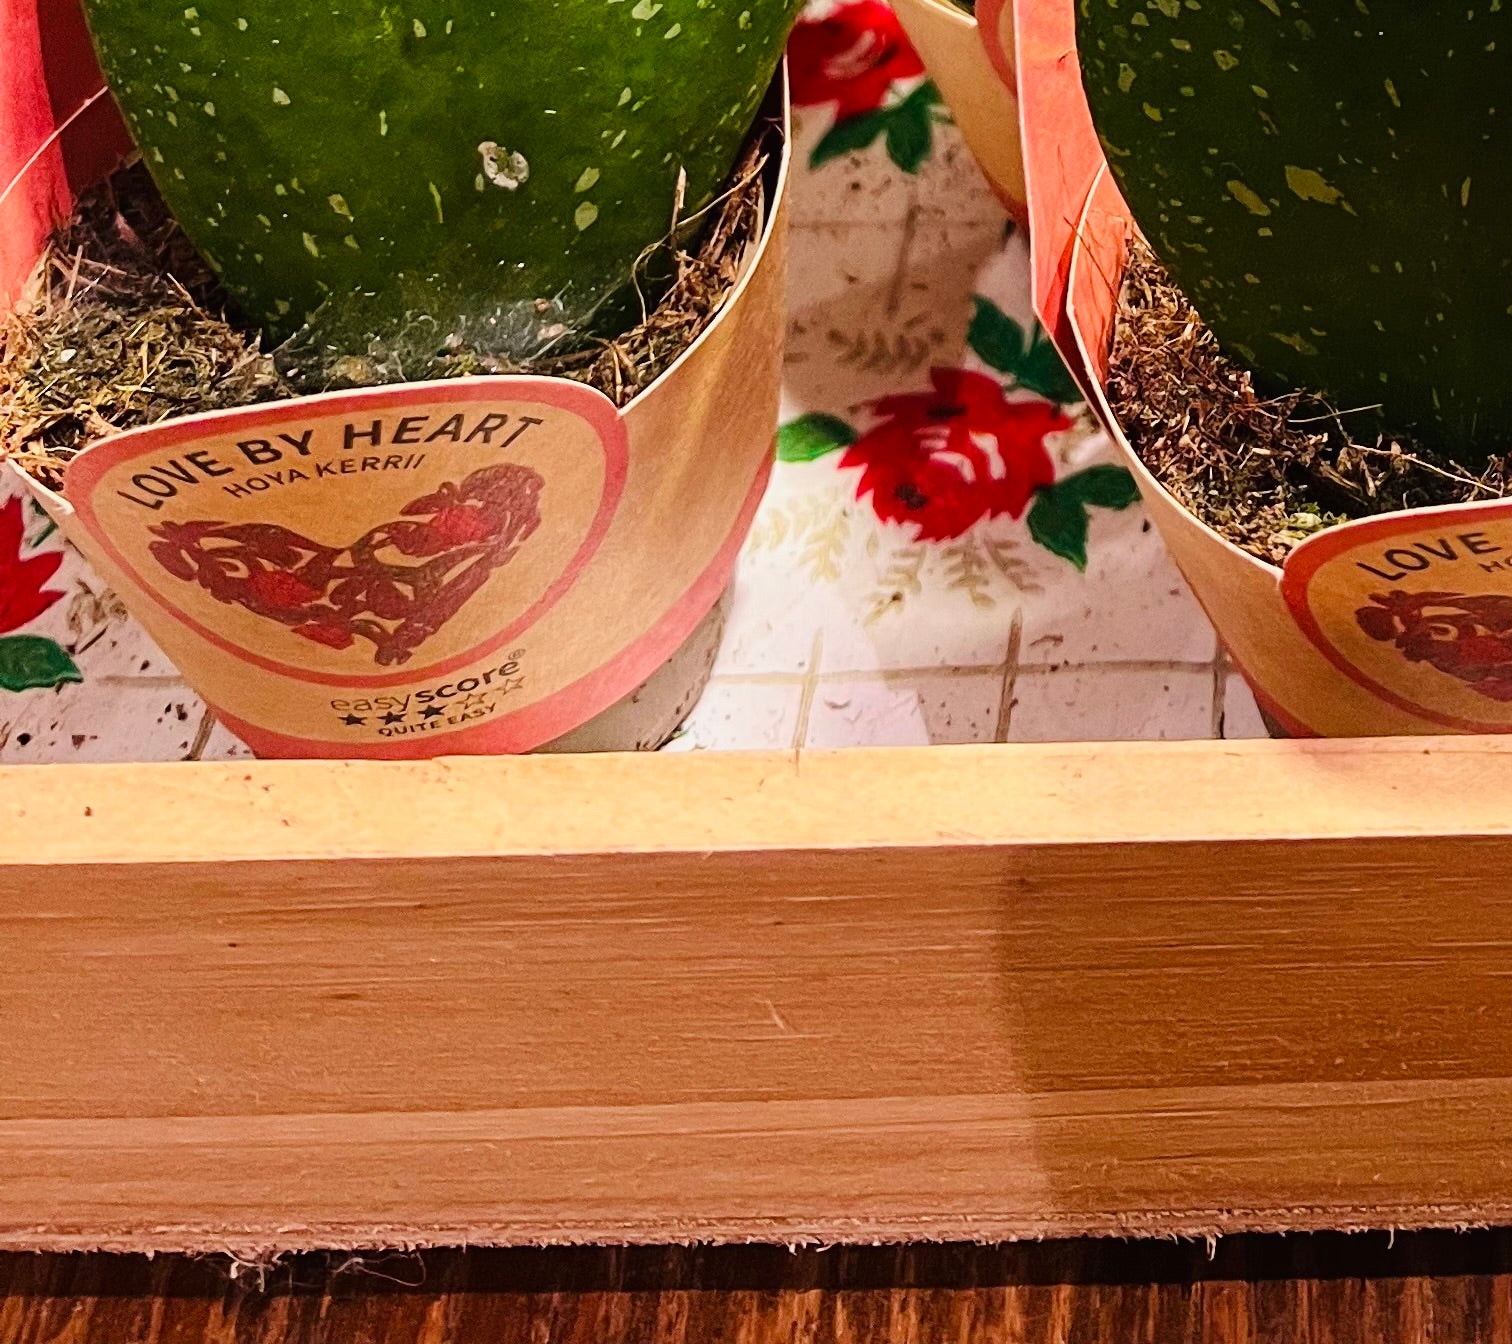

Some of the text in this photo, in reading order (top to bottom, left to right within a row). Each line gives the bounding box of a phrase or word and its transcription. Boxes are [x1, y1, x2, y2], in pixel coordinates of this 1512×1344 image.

[116, 413, 544, 511] LOVE BY HEART
[222, 453, 427, 499] HOYA KERRII
[1356, 532, 1500, 582] LOVE
[378, 702, 497, 737] QUITE EASY
